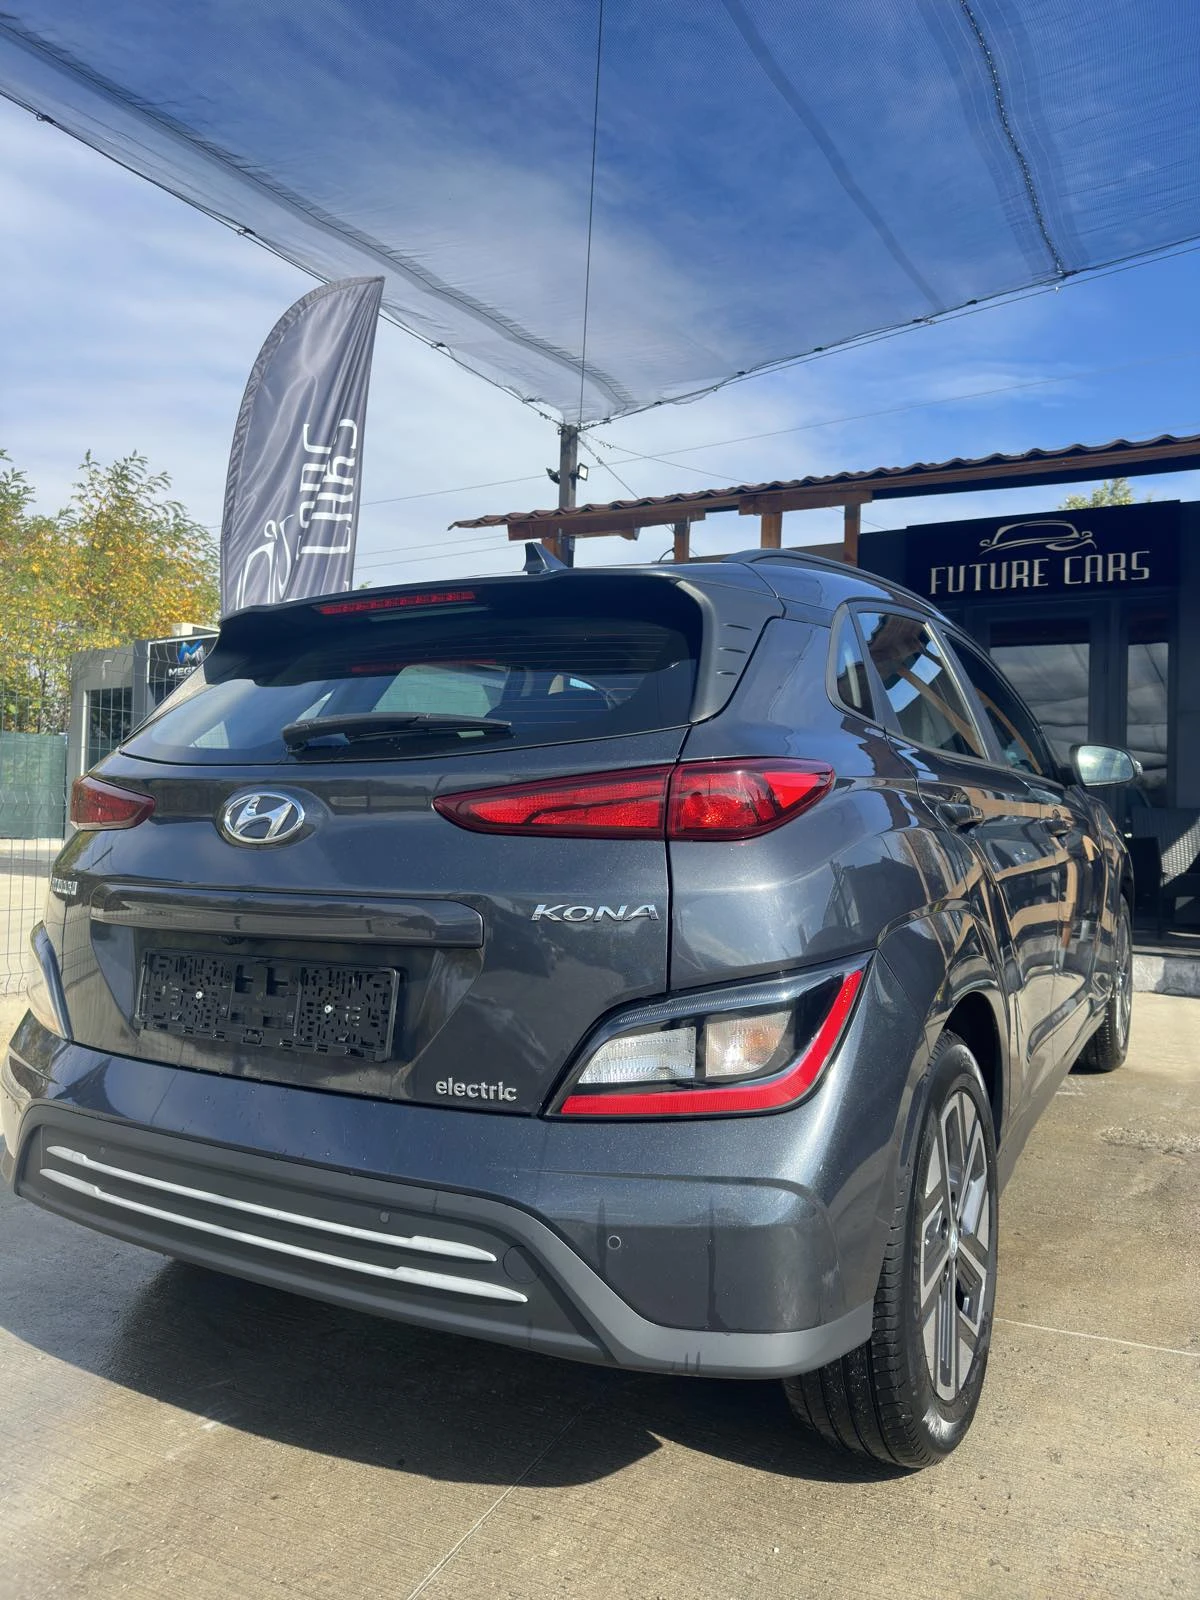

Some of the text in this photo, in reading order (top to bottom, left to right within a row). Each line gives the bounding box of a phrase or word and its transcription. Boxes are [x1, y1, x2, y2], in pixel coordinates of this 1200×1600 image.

[929, 550, 1150, 595] FUTURE CARS
[531, 903, 659, 922] KONA
[435, 1077, 517, 1101] electric
